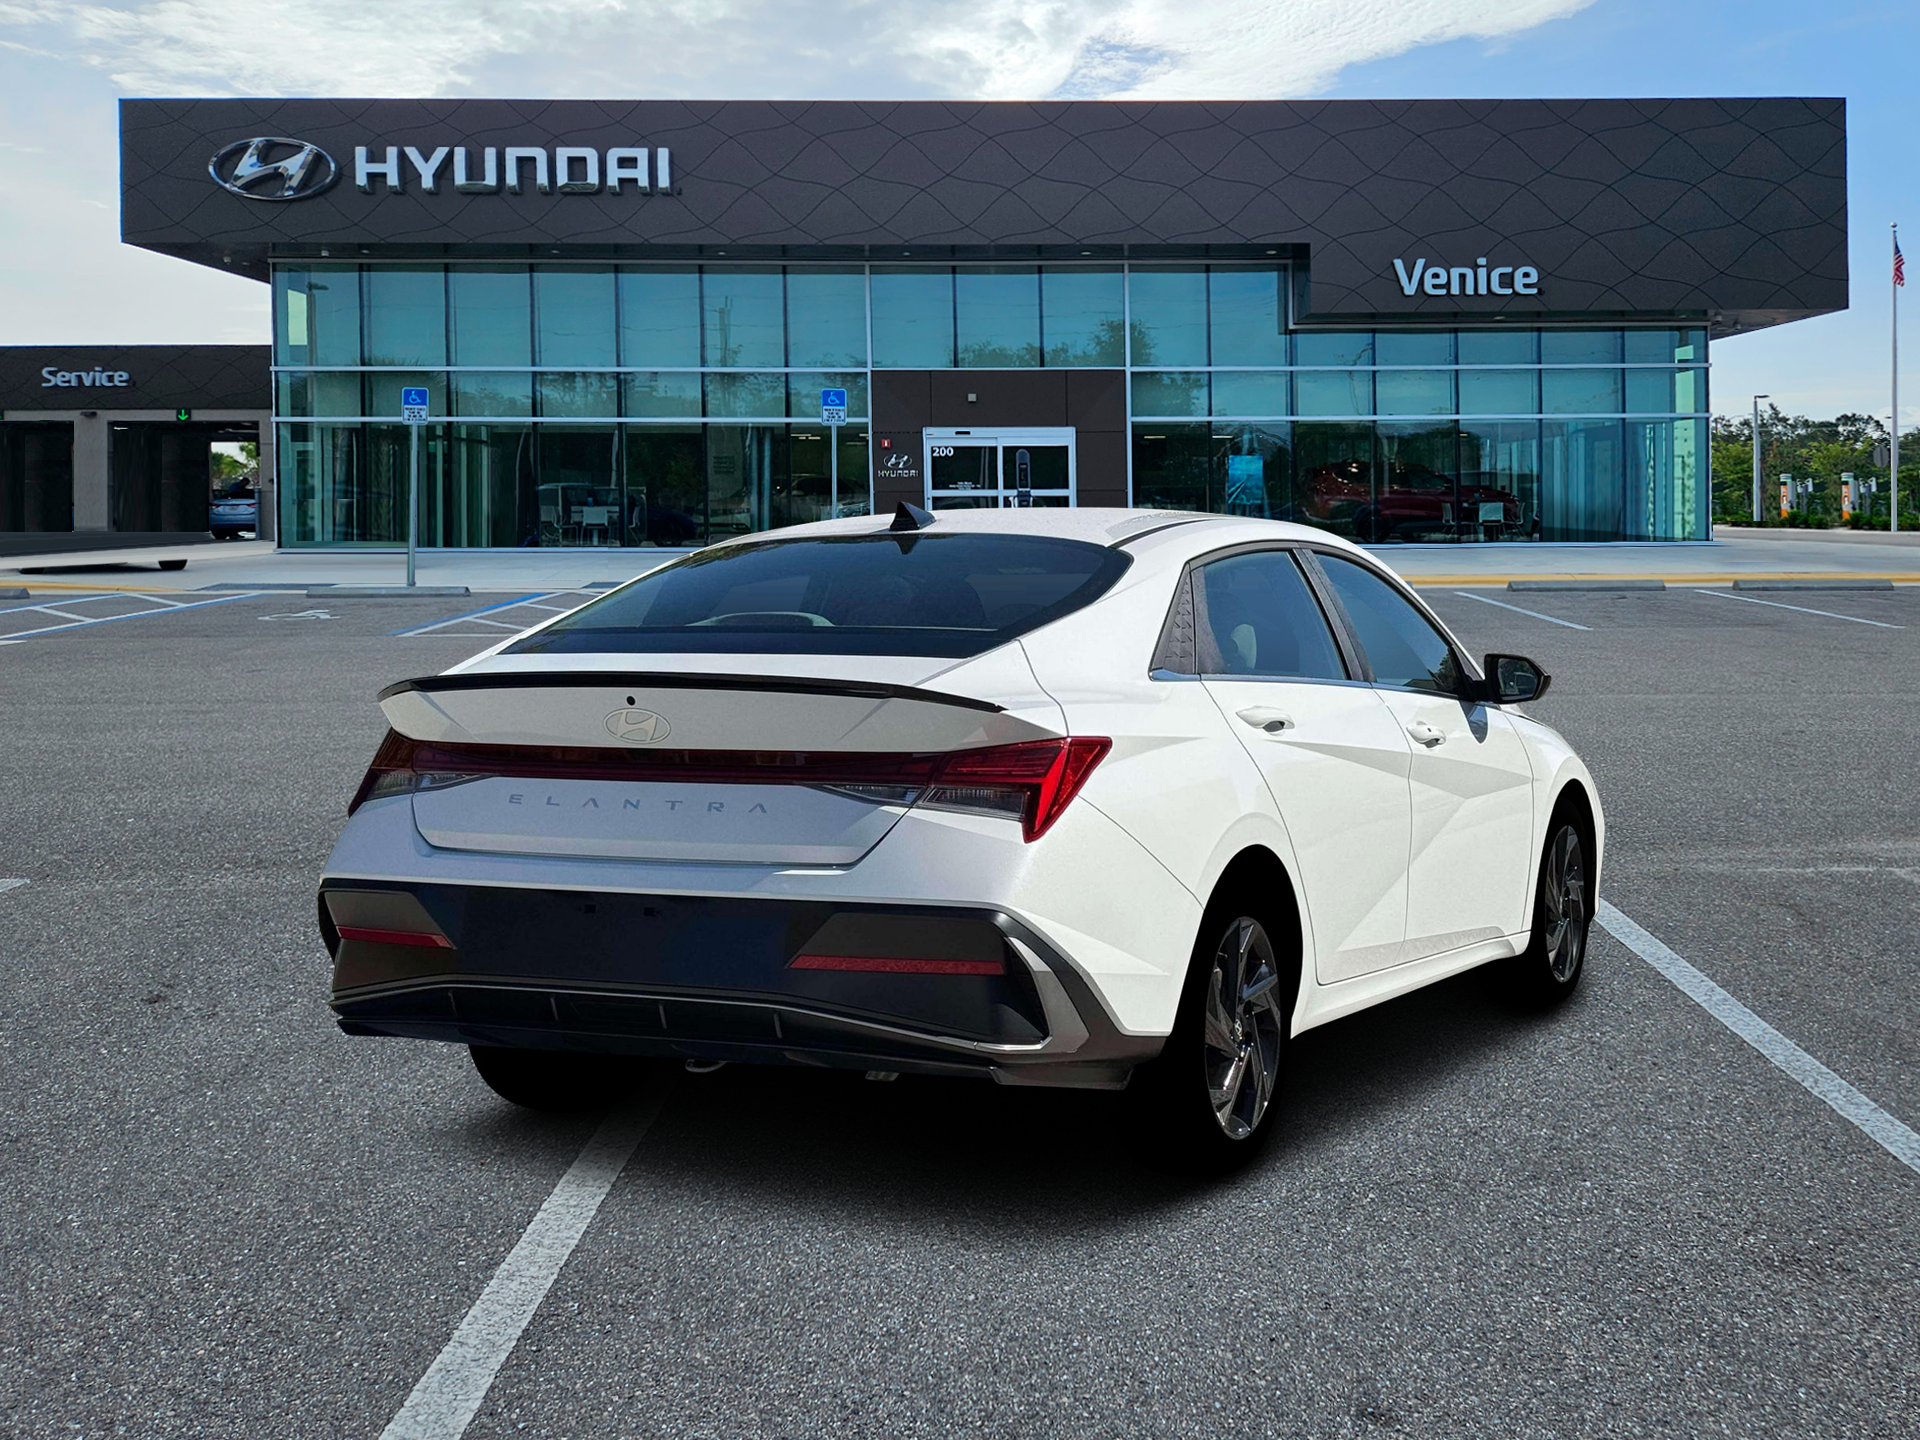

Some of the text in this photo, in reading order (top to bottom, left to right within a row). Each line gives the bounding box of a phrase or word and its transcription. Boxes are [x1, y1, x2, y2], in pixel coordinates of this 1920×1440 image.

[355, 146, 671, 193] HYUNDAI
[1393, 257, 1539, 295] Venice
[41, 366, 130, 387] Service
[932, 446, 954, 457] 200
[878, 470, 919, 478] HYUNDAI
[508, 793, 767, 813] ELANTRA
